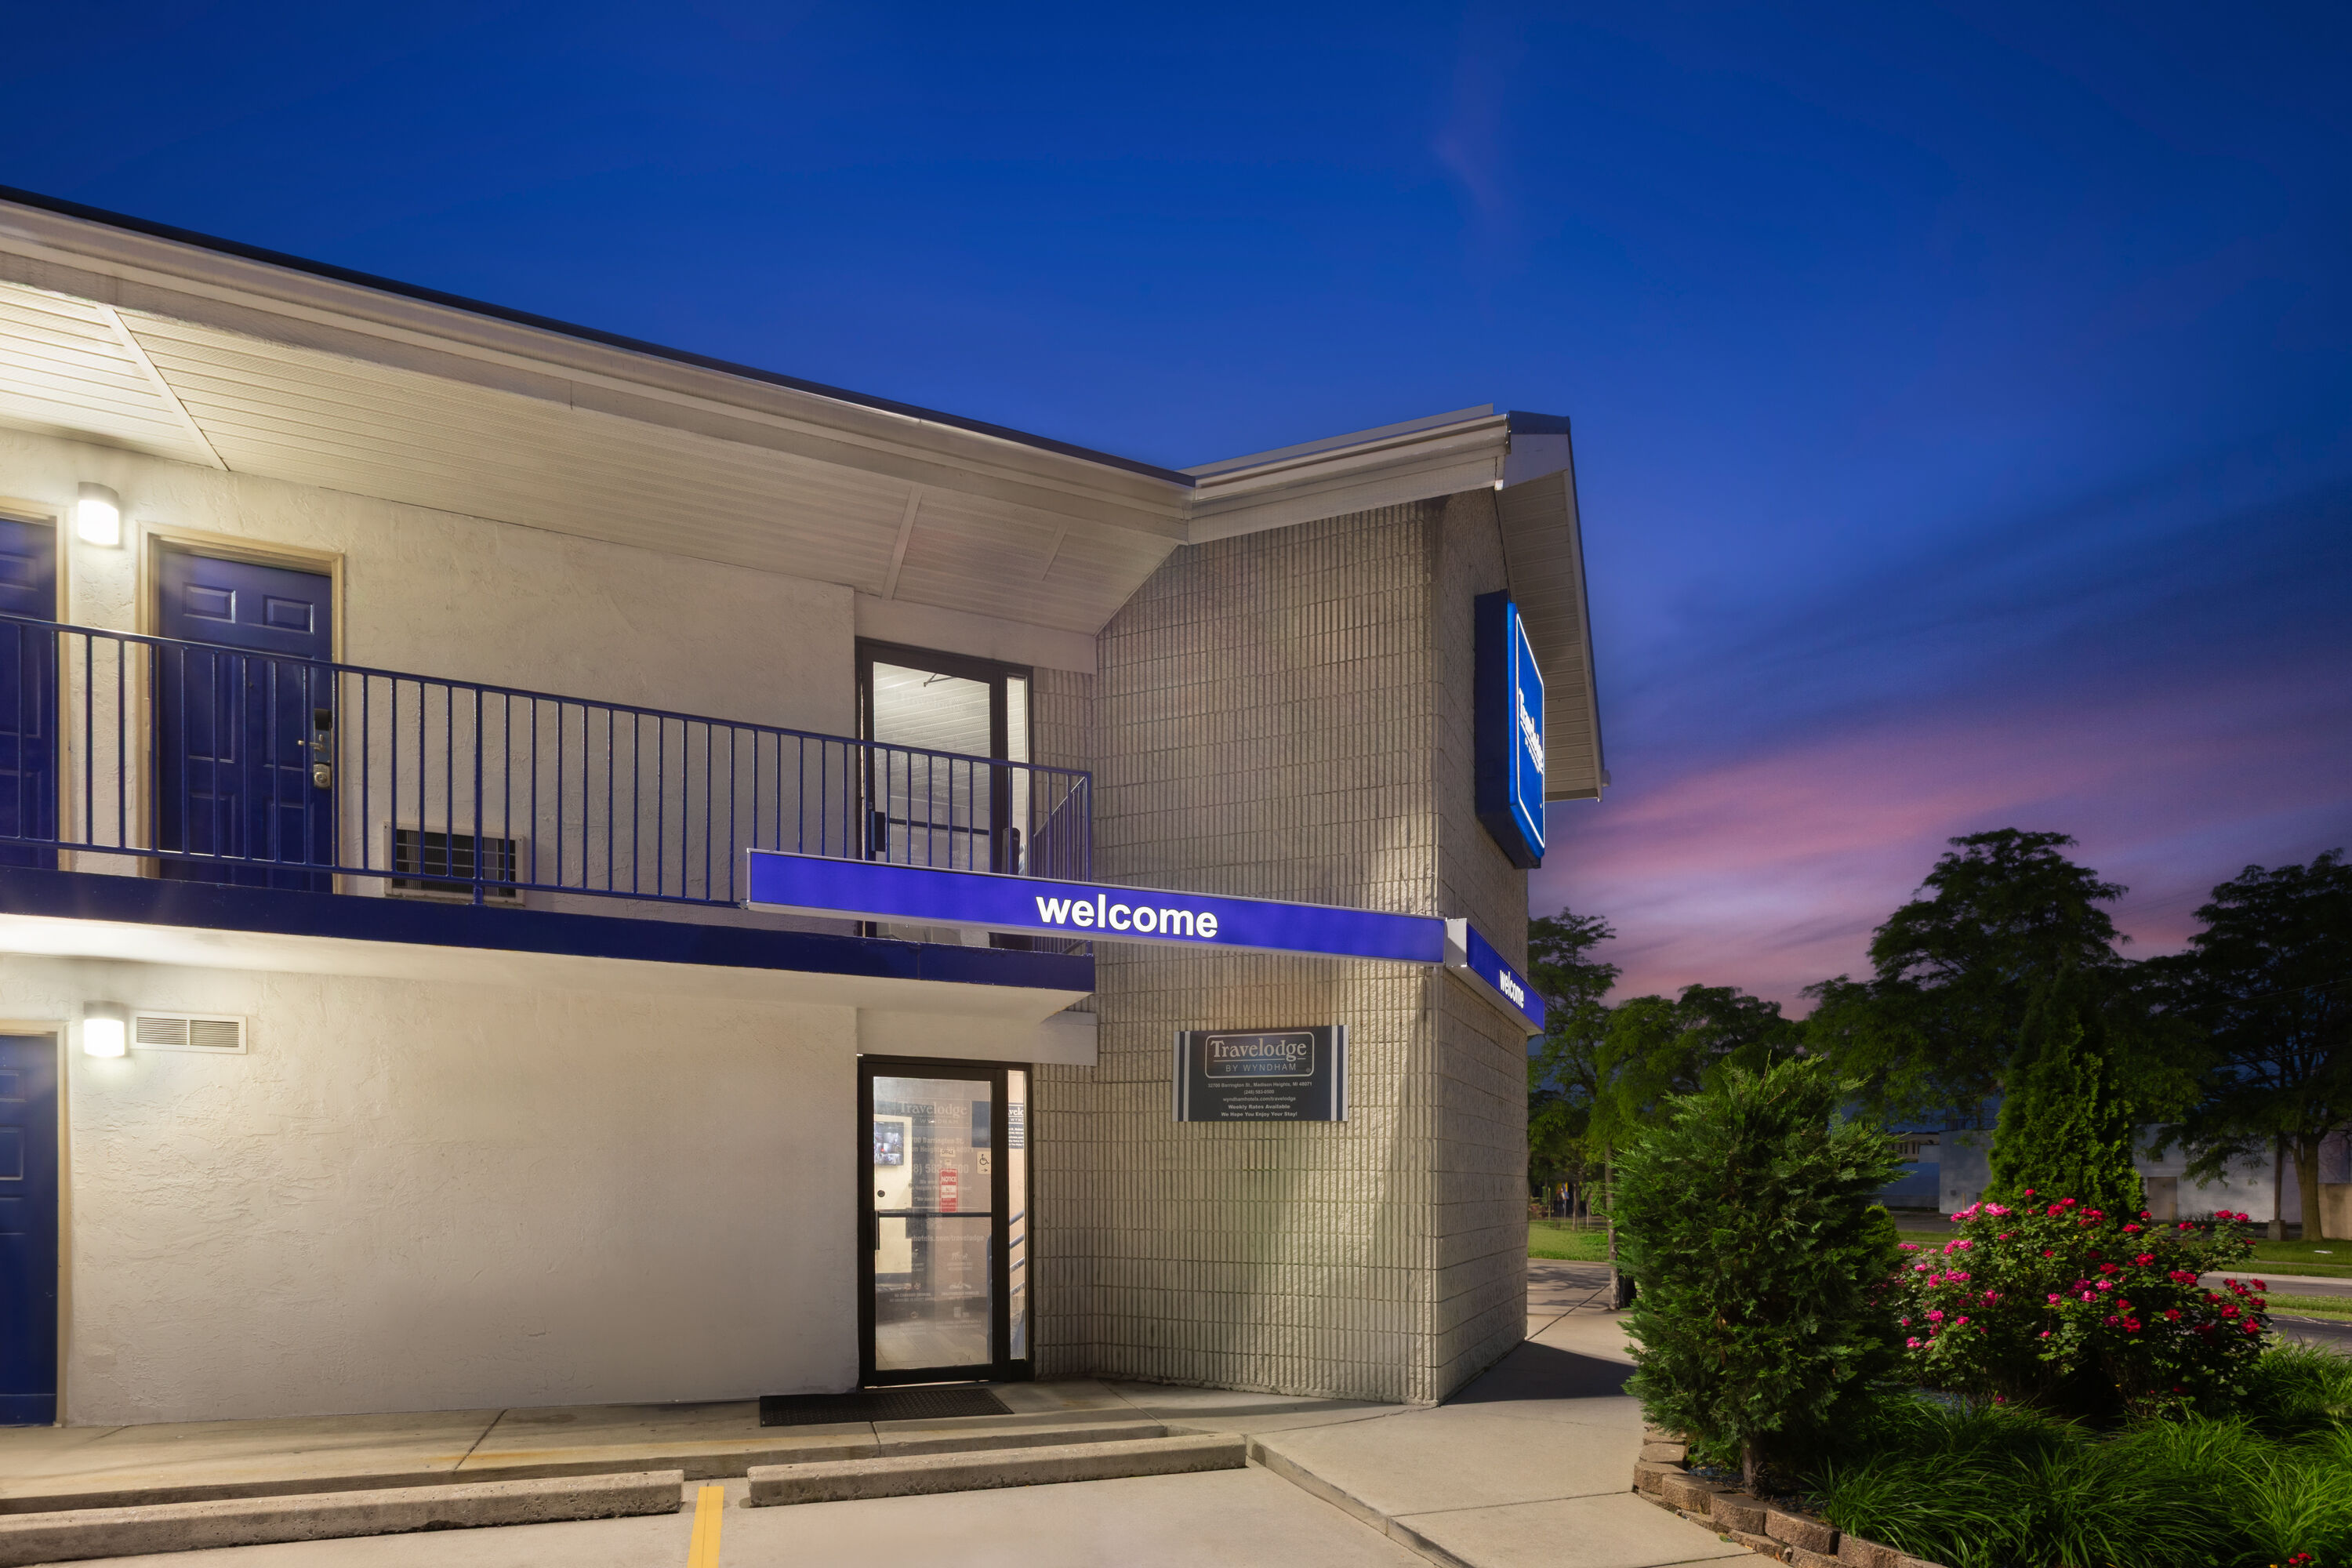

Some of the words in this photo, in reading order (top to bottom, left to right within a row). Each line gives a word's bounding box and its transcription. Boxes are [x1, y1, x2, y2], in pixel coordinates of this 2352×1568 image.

[1036, 894, 1218, 938] welcome
[1499, 969, 1524, 1009] welcome
[1210, 1037, 1307, 1062] Travelodge
[1243, 1063, 1297, 1072] WYNDHAM
[898, 1101, 967, 1120] Travelodge
